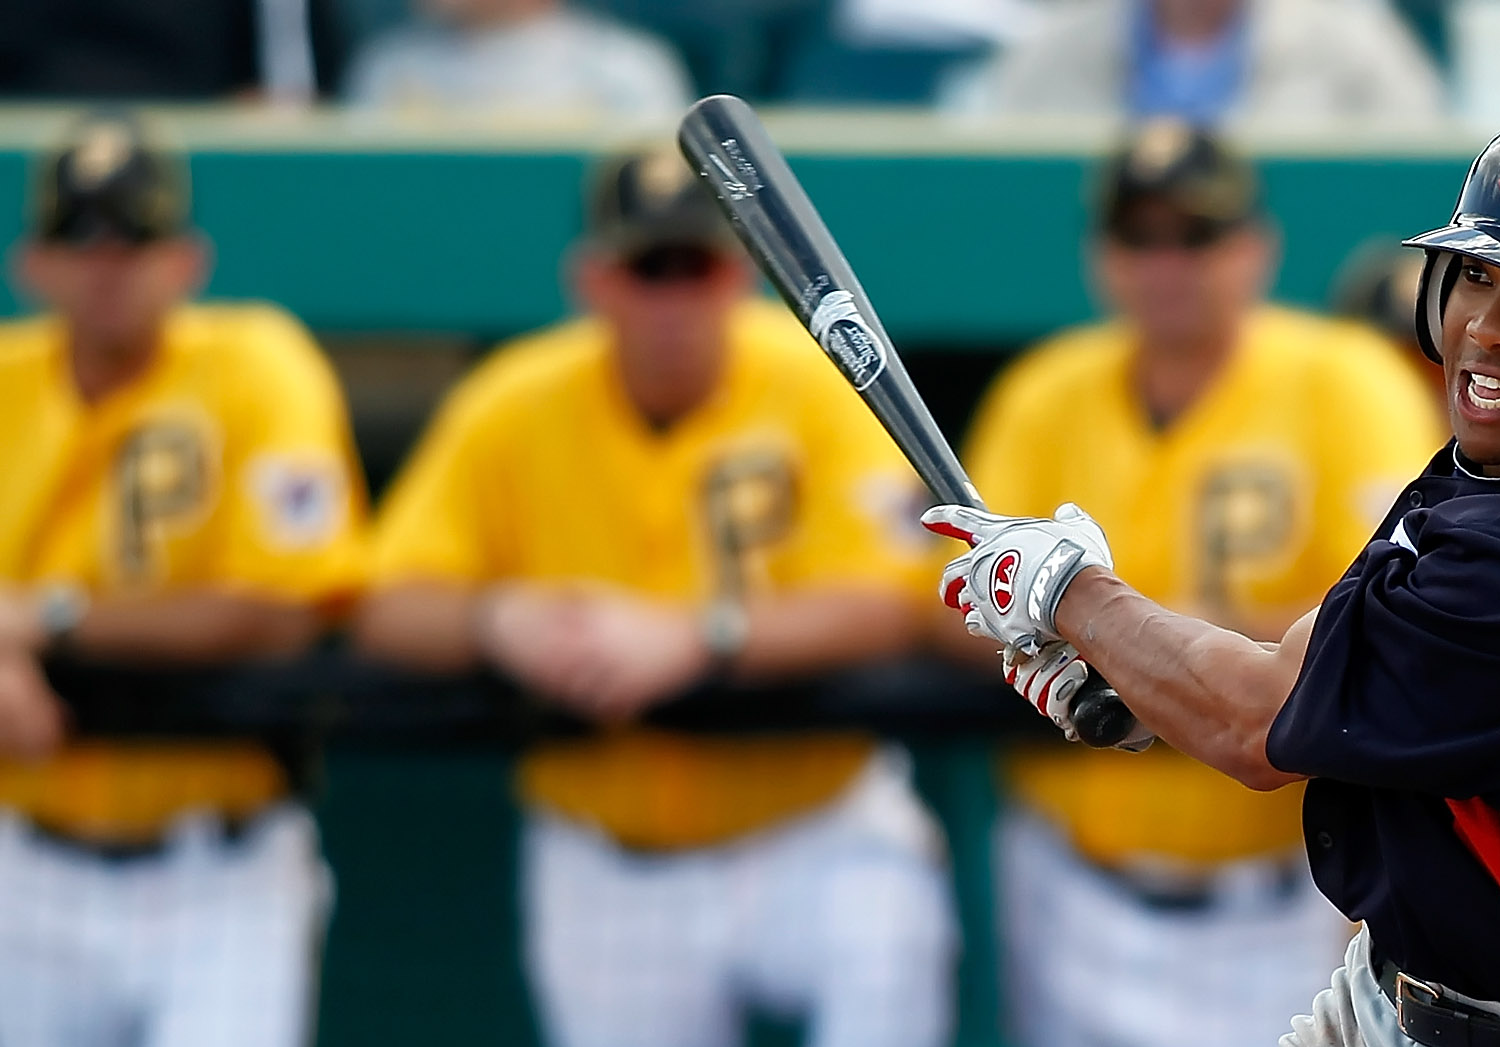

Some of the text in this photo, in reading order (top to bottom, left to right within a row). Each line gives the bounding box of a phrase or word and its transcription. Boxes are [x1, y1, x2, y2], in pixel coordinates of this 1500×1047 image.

[842, 326, 879, 367] Slugger
[106, 407, 220, 586] P
[1028, 549, 1074, 621] TPX
